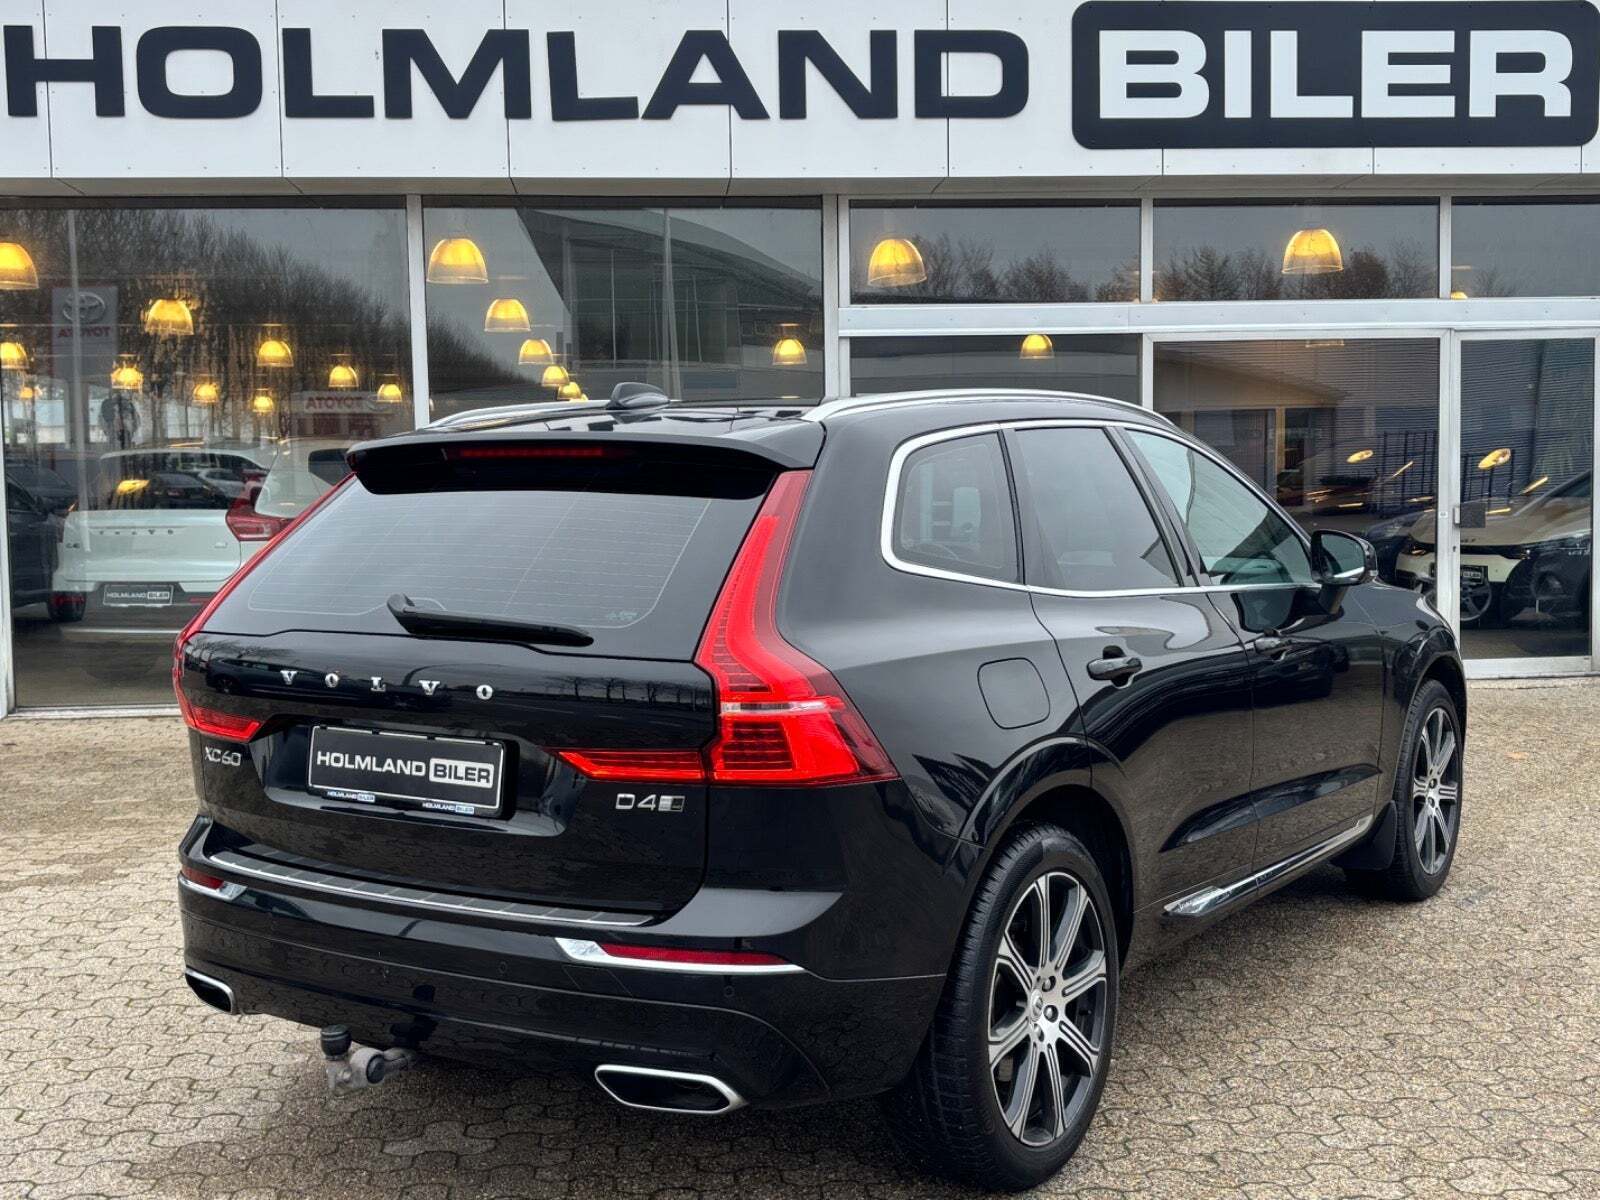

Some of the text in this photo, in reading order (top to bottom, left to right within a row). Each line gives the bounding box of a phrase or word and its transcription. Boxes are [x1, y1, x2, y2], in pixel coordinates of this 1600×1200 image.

[3, 25, 1573, 121] HOLMLAND BILER
[280, 670, 494, 700] VOLVO
[205, 746, 241, 766] XC60
[317, 751, 491, 783] HOLMLAND BILER
[327, 790, 357, 799] HOLMLAND
[616, 793, 656, 811] D4
[422, 802, 455, 811] HOLMLAND
